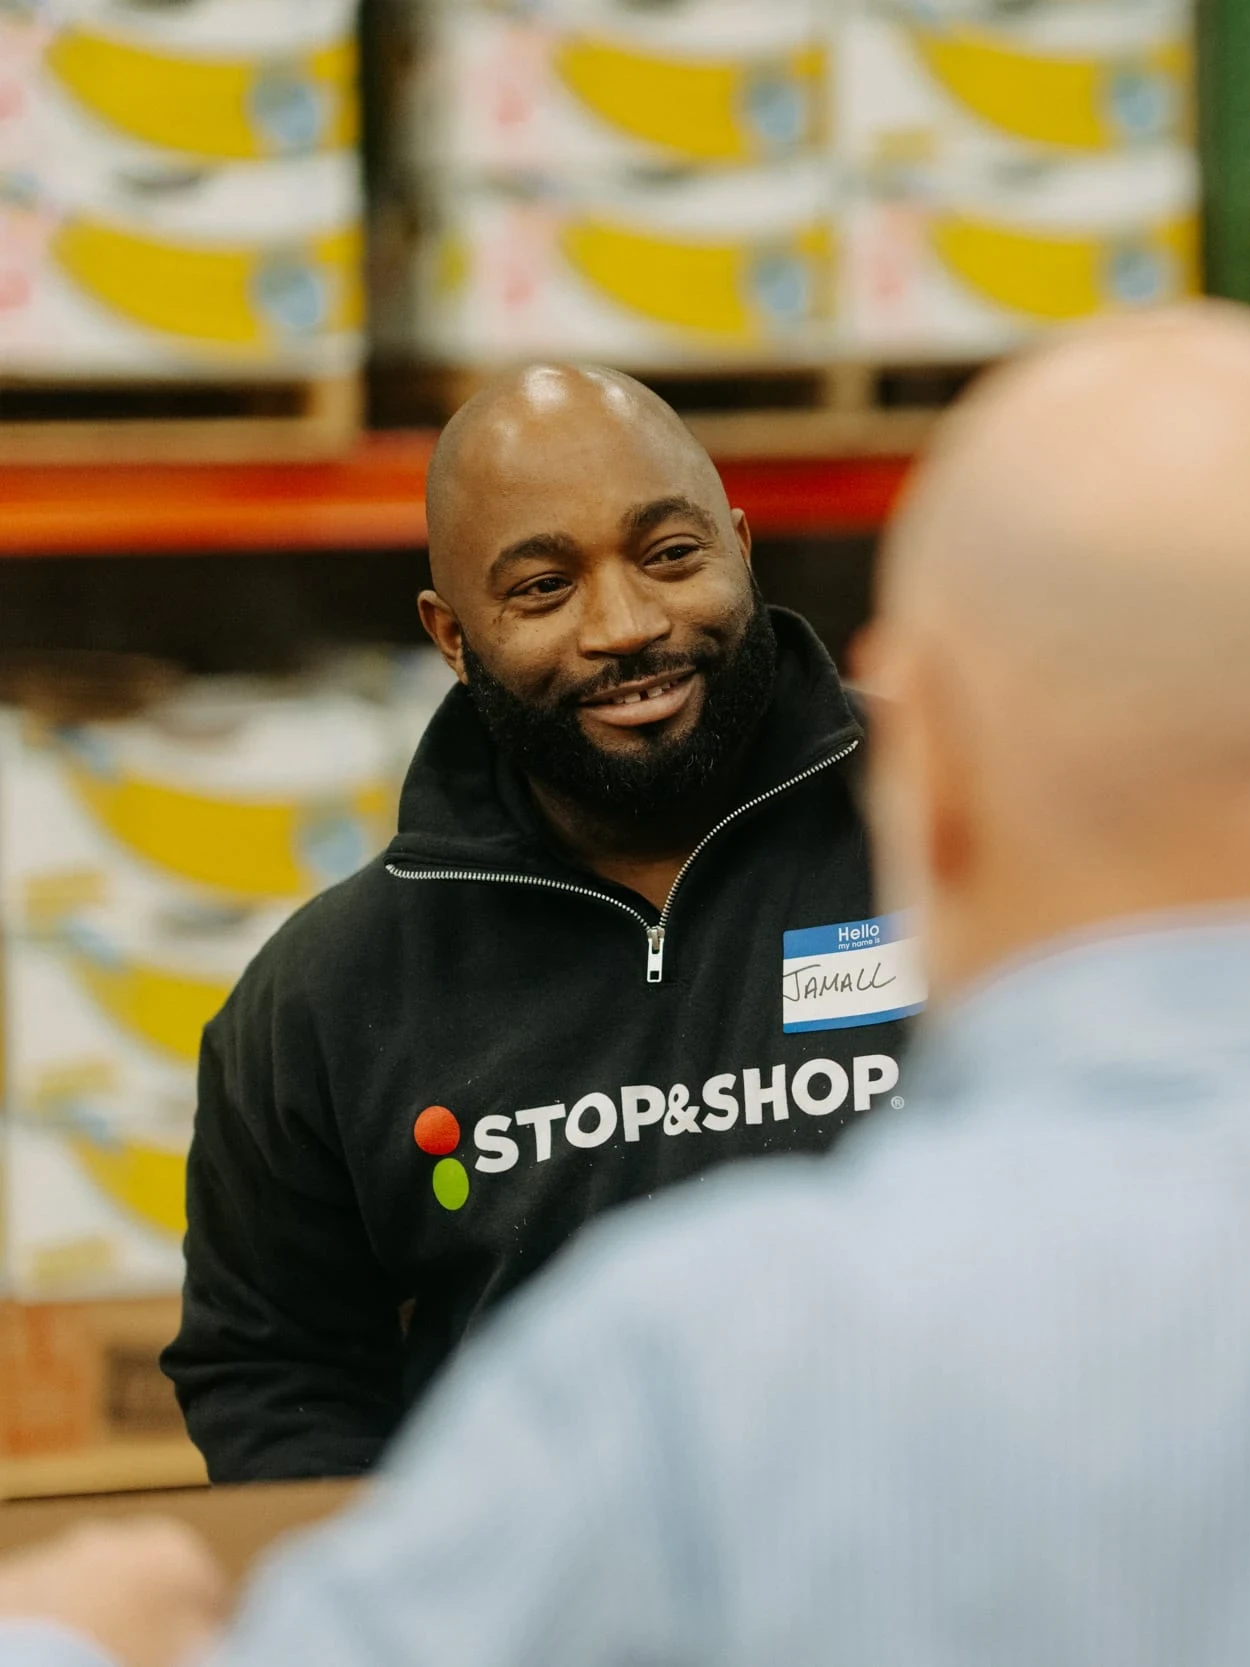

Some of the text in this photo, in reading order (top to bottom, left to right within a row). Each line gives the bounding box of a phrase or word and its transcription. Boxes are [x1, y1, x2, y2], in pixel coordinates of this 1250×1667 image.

[838, 923, 880, 942] Hello
[852, 939, 873, 948] name
[874, 937, 881, 945] is
[783, 962, 897, 1002] JAMALL
[473, 1053, 900, 1174] STOP&SHOP
